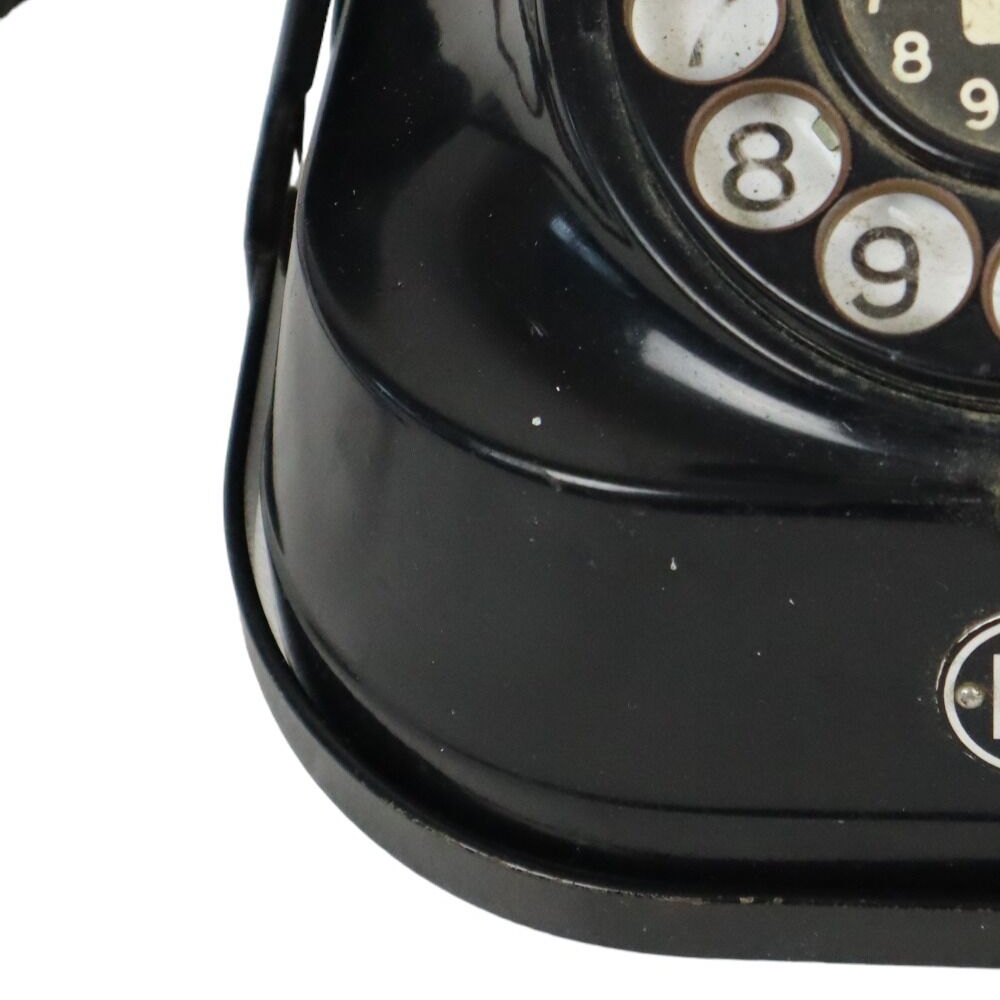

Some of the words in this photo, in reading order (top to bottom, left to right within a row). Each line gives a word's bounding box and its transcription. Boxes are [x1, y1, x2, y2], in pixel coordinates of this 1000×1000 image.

[891, 30, 933, 84] 8
[959, 77, 1000, 132] 9
[722, 121, 796, 212] 8
[850, 225, 921, 320] 9
